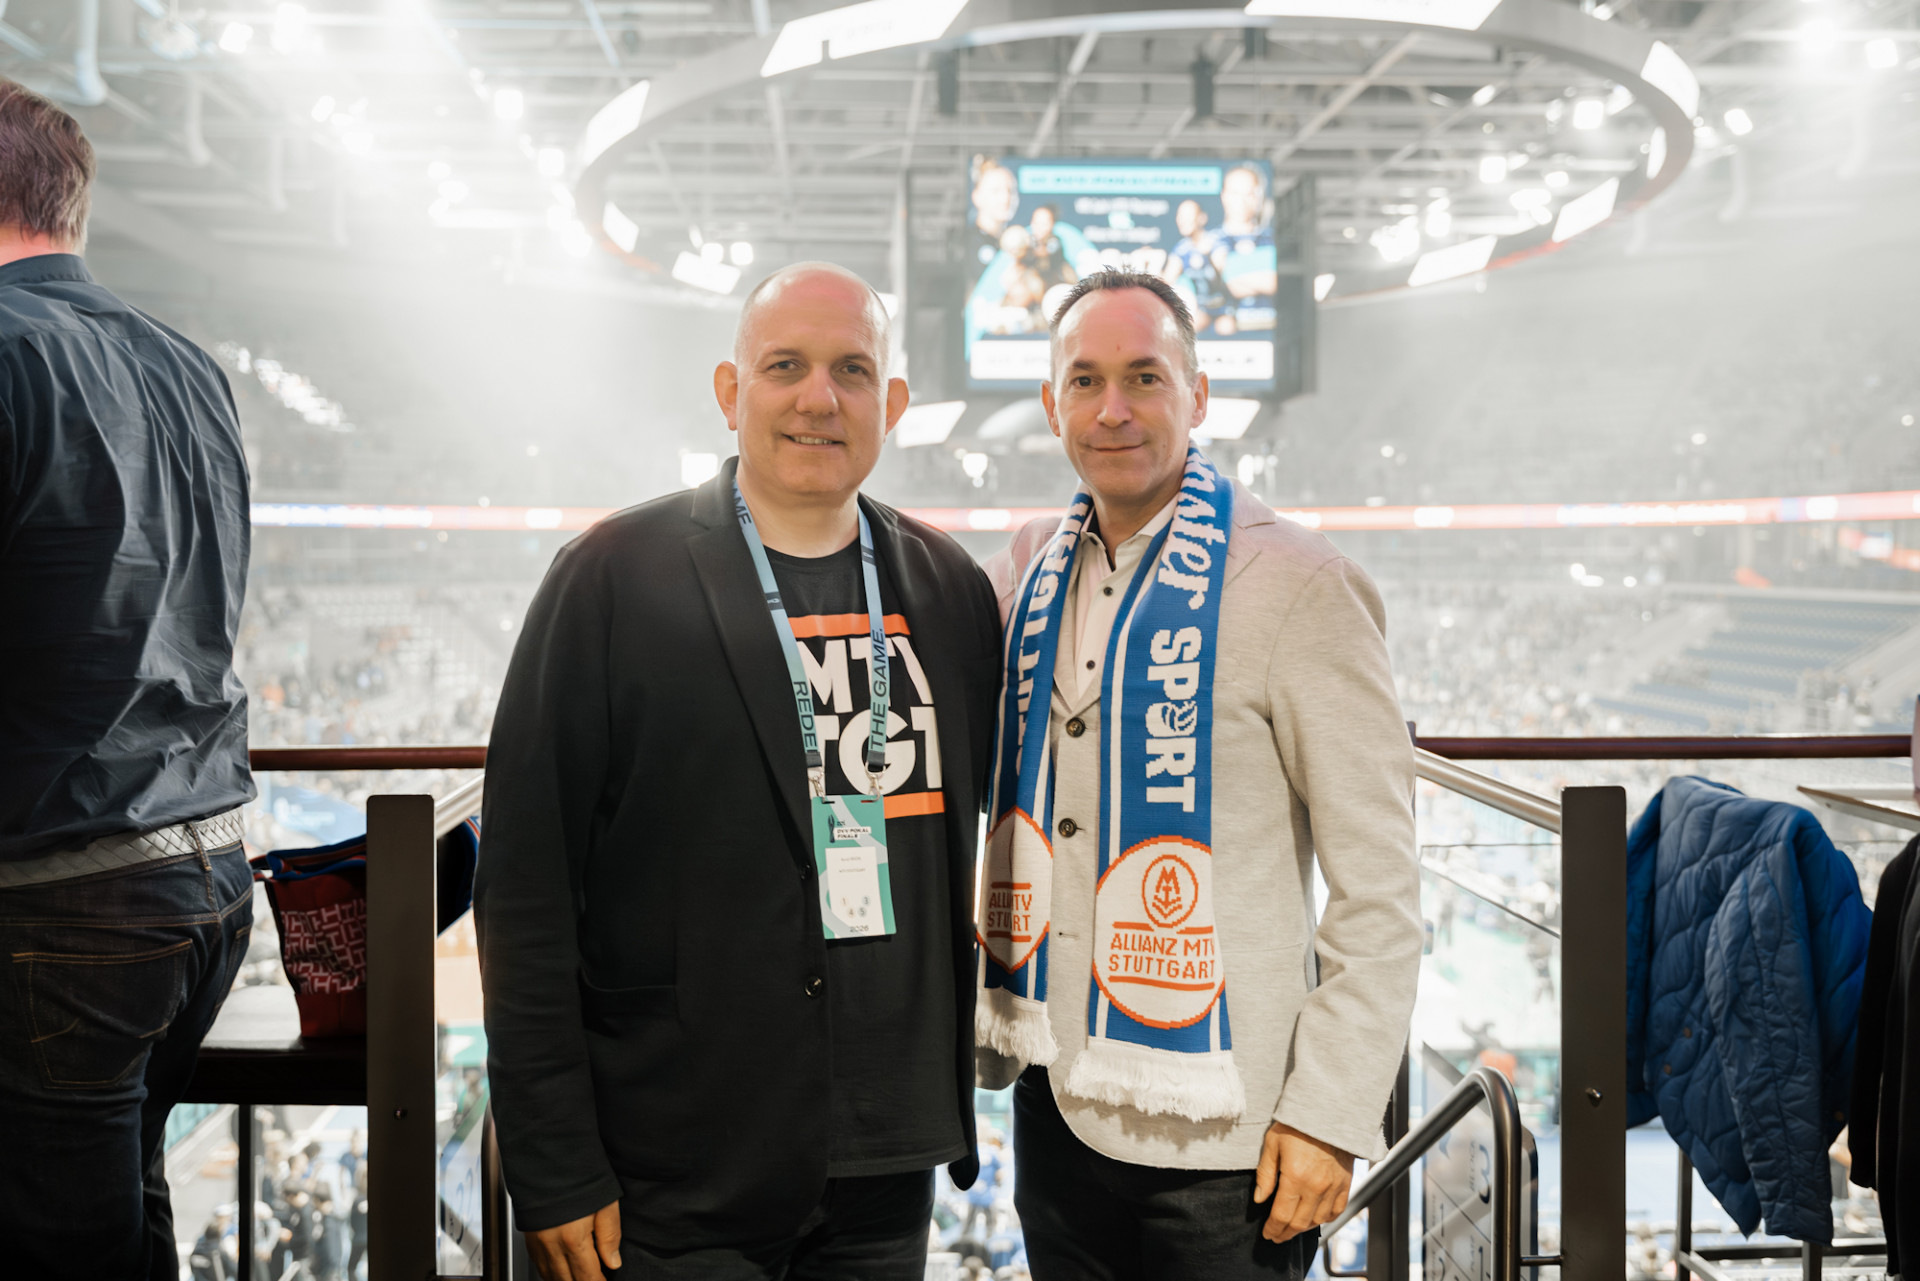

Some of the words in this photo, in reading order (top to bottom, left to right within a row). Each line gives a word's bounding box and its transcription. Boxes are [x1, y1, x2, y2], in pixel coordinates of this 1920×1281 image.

[872, 628, 889, 697] GAME.
[793, 681, 820, 754] REDE
[871, 702, 886, 749] THE
[1145, 626, 1202, 813] SPORT
[1109, 954, 1215, 979] STUTTGART
[1111, 933, 1178, 956] ALLIANZ
